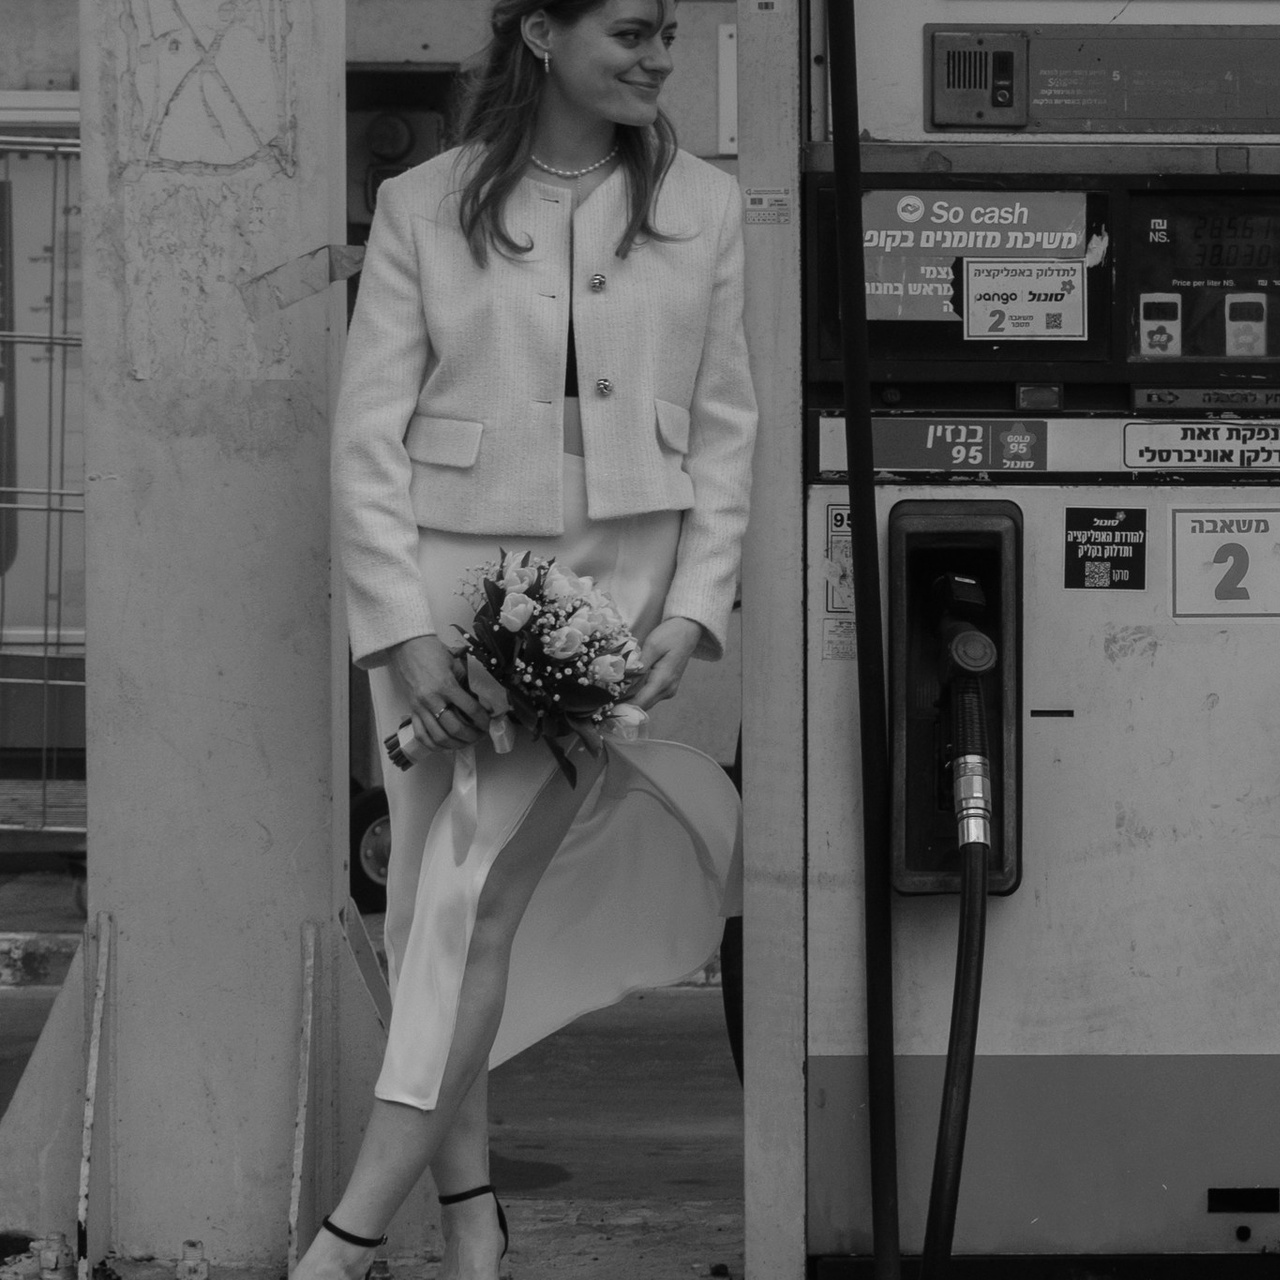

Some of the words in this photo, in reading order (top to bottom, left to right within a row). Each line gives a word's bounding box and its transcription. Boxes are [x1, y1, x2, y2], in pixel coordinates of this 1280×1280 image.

[1112, 70, 1121, 81] 5
[931, 201, 965, 224] So
[970, 202, 1029, 224] cash
[919, 230, 1001, 248] מזומנים
[1006, 231, 1077, 250] משיכת
[1149, 231, 1171, 243] NS.
[973, 266, 1033, 280] באפליקציה
[1035, 266, 1077, 280] לתדלוק
[1172, 279, 1191, 287] Price
[1193, 279, 1205, 288] per
[1206, 279, 1221, 287] liter
[1027, 290, 1066, 302] סונול
[987, 309, 1006, 333] 2
[926, 424, 984, 449] בנזין
[1007, 434, 1030, 443] GOLD
[1180, 426, 1221, 441] זאת
[951, 445, 983, 464] 95
[1009, 442, 1028, 454] 95
[1138, 446, 1235, 463] אוניברסלי
[1002, 458, 1035, 469] סונול
[1190, 518, 1270, 535] משאבה
[1066, 529, 1113, 545] האפליקציה
[1078, 544, 1102, 559] בקליק
[1212, 542, 1250, 601] 2
